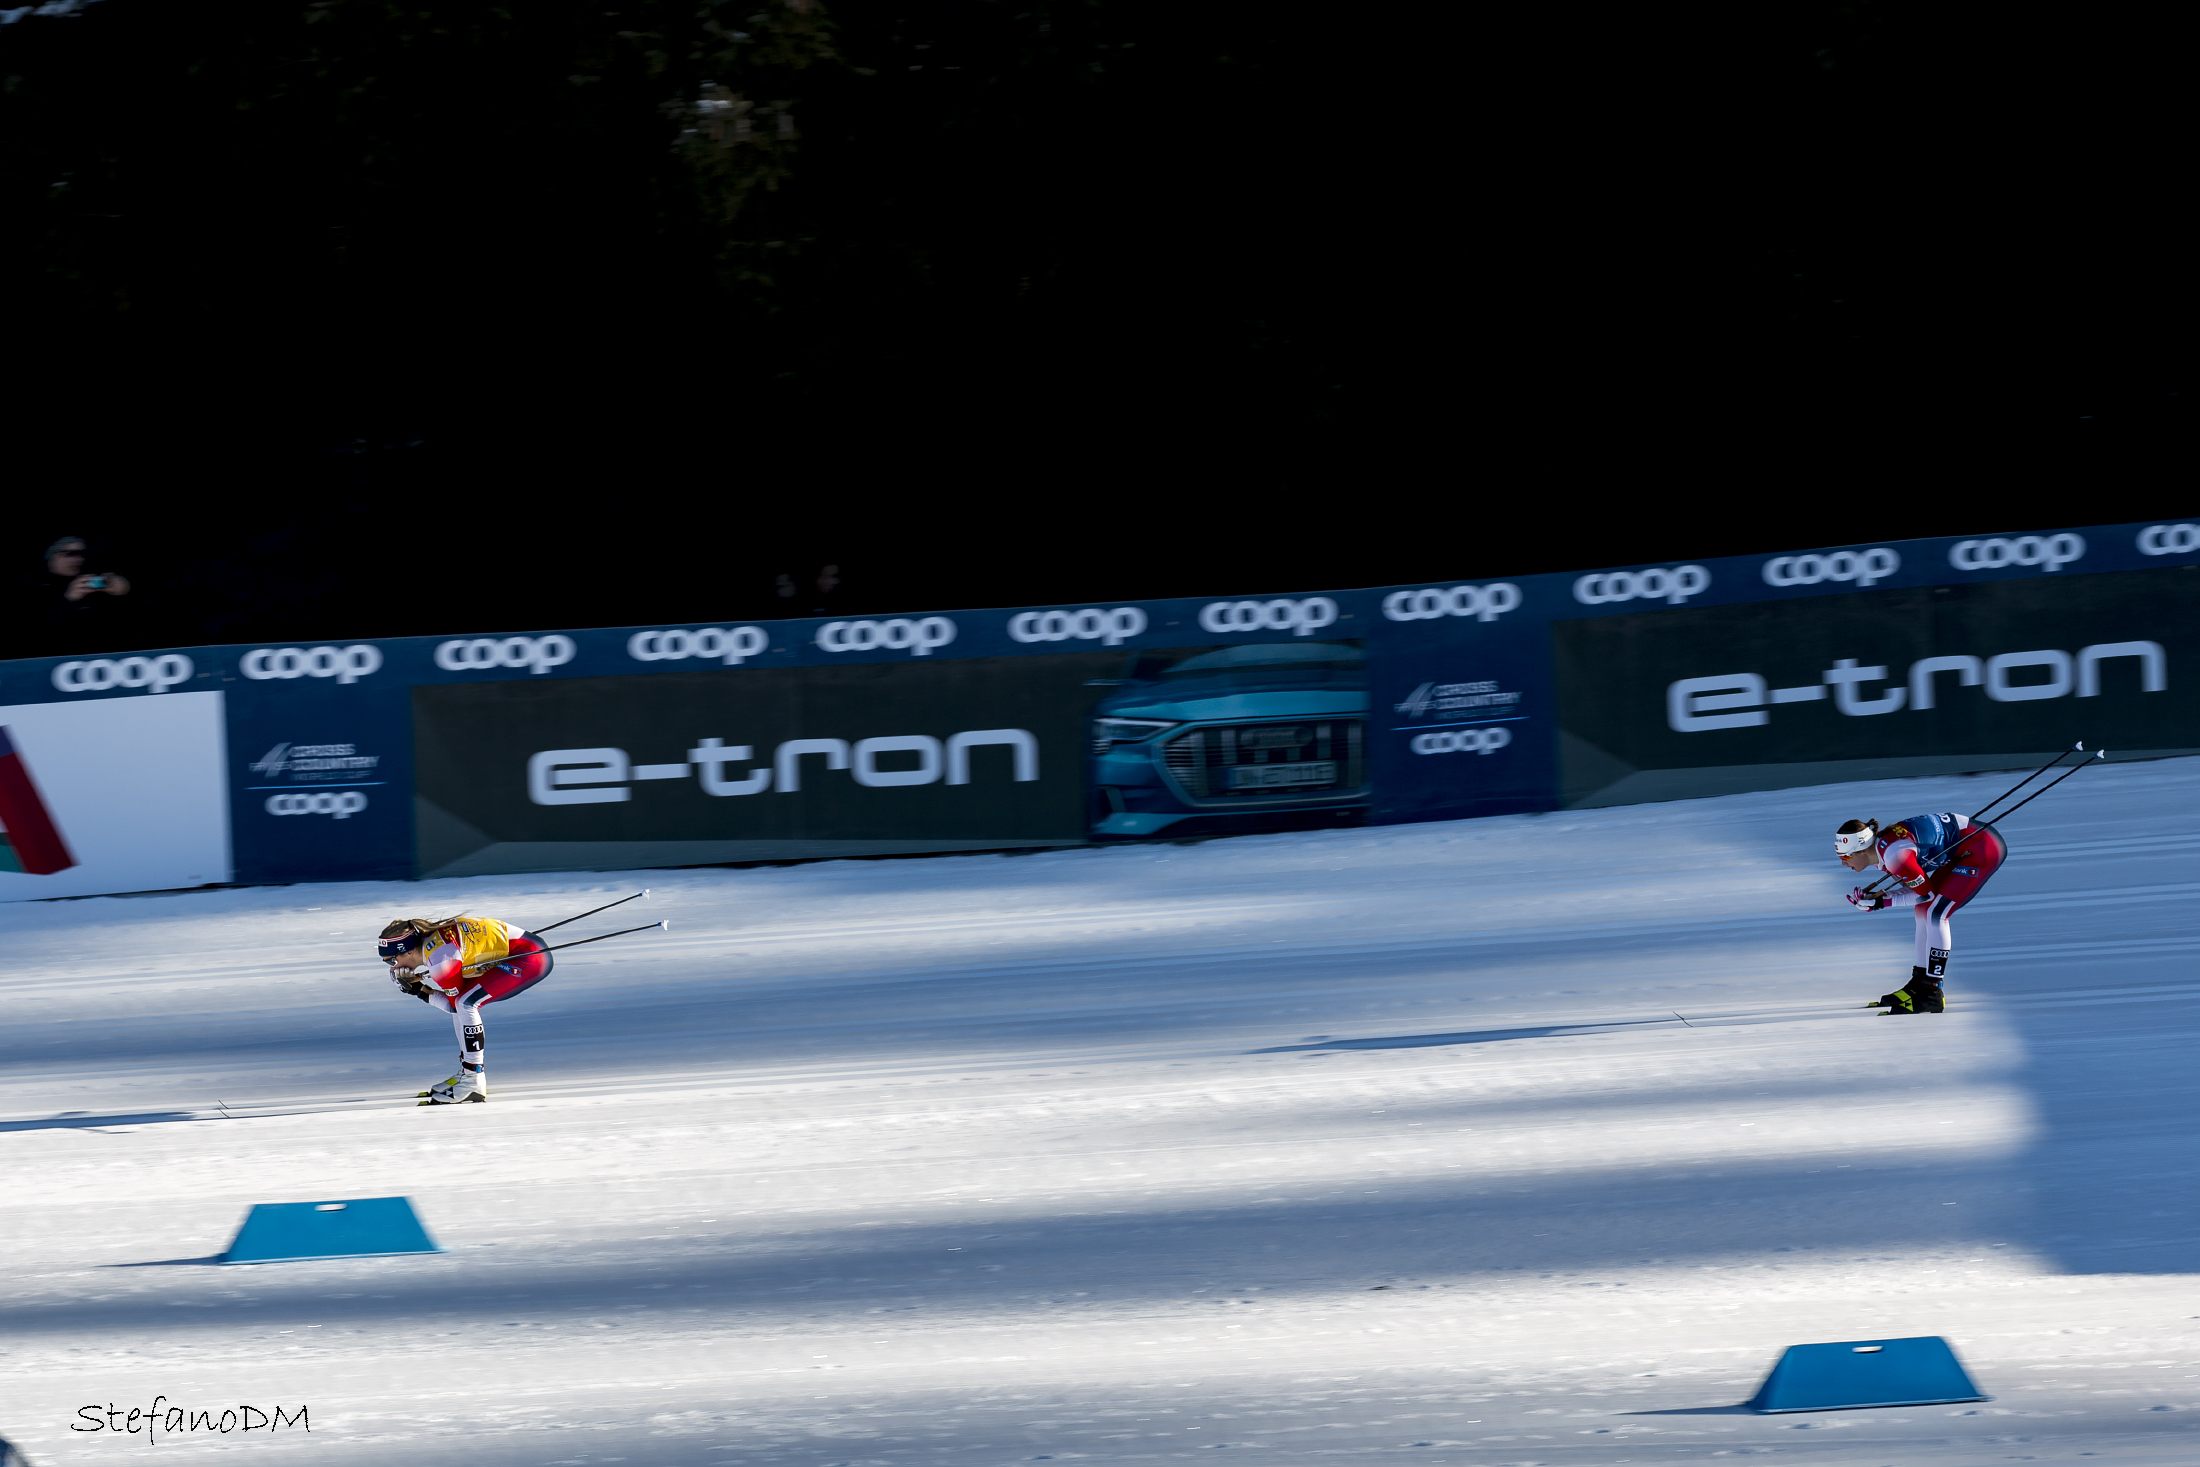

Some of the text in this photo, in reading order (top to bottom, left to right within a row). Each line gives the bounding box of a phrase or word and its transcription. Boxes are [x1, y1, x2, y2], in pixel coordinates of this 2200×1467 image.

[52, 653, 194, 694] coop
[240, 644, 382, 685] coop
[436, 634, 574, 675] coop
[628, 625, 768, 666] coop
[816, 616, 956, 657] coop
[1008, 606, 1147, 646] coop
[1200, 596, 1337, 637] coop
[1382, 582, 1521, 623] coop
[1573, 564, 1710, 605] coop
[1763, 547, 1899, 587] coop
[1949, 532, 2085, 573] coop
[1666, 640, 2167, 733] e-tron
[1409, 727, 1512, 755] coop
[527, 728, 1039, 806] e-tron
[264, 791, 368, 819] coop
[1933, 964, 1942, 975] 2
[472, 1040, 481, 1051] 1
